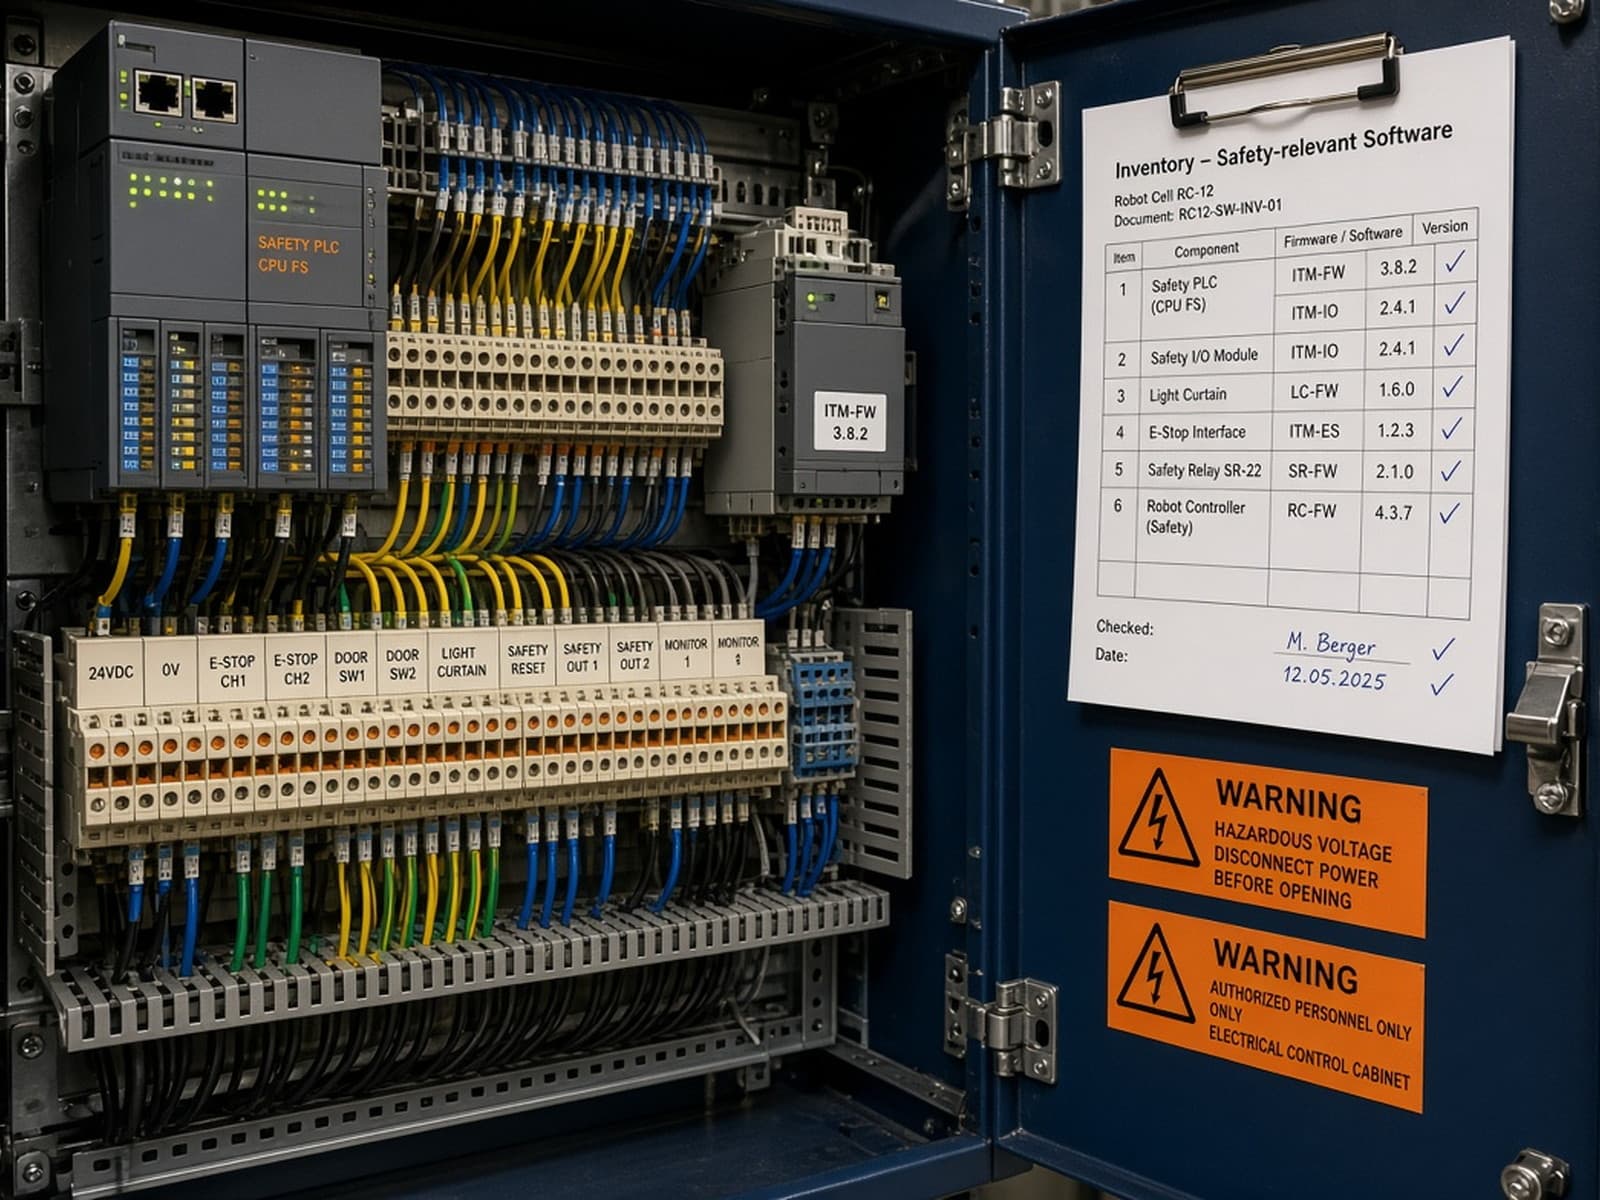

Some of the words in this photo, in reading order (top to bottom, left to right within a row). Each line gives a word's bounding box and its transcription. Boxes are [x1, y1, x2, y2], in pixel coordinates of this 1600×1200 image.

[1115, 156, 1195, 180] Inventory
[1216, 132, 1358, 167] Safety-relevant
[1363, 123, 1453, 149] Software
[1114, 192, 1149, 208] Robot
[1151, 188, 1174, 204] Cell
[1177, 183, 1214, 201] RC-12
[1114, 210, 1174, 228] Document:
[1178, 198, 1282, 221] RC12-SW-INV-01
[1421, 219, 1469, 235] Version
[258, 235, 311, 252] SAFETY
[312, 239, 339, 254] PLC
[1284, 233, 1338, 249] Firmware
[1349, 226, 1403, 243] Software
[1174, 241, 1240, 260] Component
[258, 257, 288, 273] CPU
[290, 260, 309, 273] FS
[1292, 264, 1346, 283] ITM-FW
[1380, 258, 1417, 277] 3.8.2
[1119, 282, 1126, 297] 1
[1151, 277, 1190, 295] Safety
[1192, 274, 1218, 290] PLC
[1151, 298, 1182, 317] (CPU
[1185, 296, 1207, 314] FS)
[1292, 303, 1339, 321] ITM-IO
[1379, 299, 1415, 316] 2.4.1
[1291, 342, 1339, 360] ITM-IO
[1379, 340, 1415, 357] 2.4.1
[1117, 352, 1126, 367] 2
[1150, 350, 1189, 368] Safety
[1191, 348, 1211, 364] I/O
[1213, 347, 1259, 363] Module
[1116, 388, 1126, 404] 3
[1149, 388, 1180, 406] Light
[1182, 386, 1227, 402] Curtain
[1291, 383, 1339, 400] LC-FW
[1379, 380, 1415, 398] 1.6.0
[824, 403, 877, 419] ITM-FW
[833, 425, 868, 441] 3.8.2
[1115, 425, 1124, 439] 4
[1149, 424, 1190, 443] E-Stop
[1192, 424, 1247, 439] Interface
[1289, 423, 1340, 439] ITM-ES
[1378, 422, 1415, 438] 1.2.3
[1114, 461, 1124, 477] 5
[1148, 462, 1186, 481] Safety
[1188, 462, 1221, 481] Relay
[1223, 463, 1262, 478] SR-22
[1288, 463, 1338, 479] SR-FW
[1376, 463, 1414, 480] 2.1.0
[1113, 497, 1123, 513] 6
[1146, 498, 1183, 514] Robot
[1185, 499, 1246, 515] Controller
[1287, 502, 1337, 519] RC-FW
[1374, 504, 1413, 521] 4.3.7
[1146, 519, 1193, 537] (Safety)
[1096, 618, 1154, 636] Checked:
[507, 643, 549, 658] SAFETY
[563, 642, 602, 656] SAFETY
[616, 640, 654, 653] SAFETY
[664, 637, 708, 651] MONITOR
[717, 635, 760, 649] MONITOR
[1286, 631, 1307, 652] M.
[1316, 631, 1377, 664] Berger
[273, 652, 319, 667] E-STOP
[334, 650, 368, 665] DOOR
[386, 648, 420, 662] DOOR
[441, 646, 476, 660] LIGHT
[1095, 646, 1129, 663] Date:
[162, 662, 181, 677] 0V
[209, 654, 256, 670] E-STOP
[436, 663, 487, 678] CURTAIN
[511, 661, 546, 675] RESET
[566, 659, 589, 673] OUT
[592, 659, 598, 671] 1
[620, 657, 642, 671] OUT
[642, 657, 650, 670] 2
[684, 655, 690, 669] 1
[88, 664, 134, 681] 24VDC
[284, 671, 310, 686] CH2
[339, 669, 365, 683] SW1
[389, 666, 417, 681] SW2
[1284, 665, 1387, 691] 12.05.2025
[220, 674, 246, 689] CH1
[1216, 778, 1361, 824] WARNING
[1214, 820, 1313, 851] HAZARDOUS
[1317, 835, 1392, 864] VOLTAGE
[1214, 844, 1314, 877] DISCONNECT
[1319, 861, 1379, 889] POWER
[1214, 869, 1274, 896] BEFORE
[1279, 881, 1352, 910] OPENING
[1213, 938, 1358, 995] WARNING
[1209, 1001, 1242, 1024] ONLY
[1210, 979, 1291, 1012] AUTHORIZED
[1294, 999, 1374, 1033] PERSONNEL
[1376, 1018, 1412, 1042] ONLY
[1209, 1024, 1284, 1058] ELECTRICAL
[1286, 1044, 1349, 1074] CONTROL
[1352, 1061, 1411, 1091] CABINET
